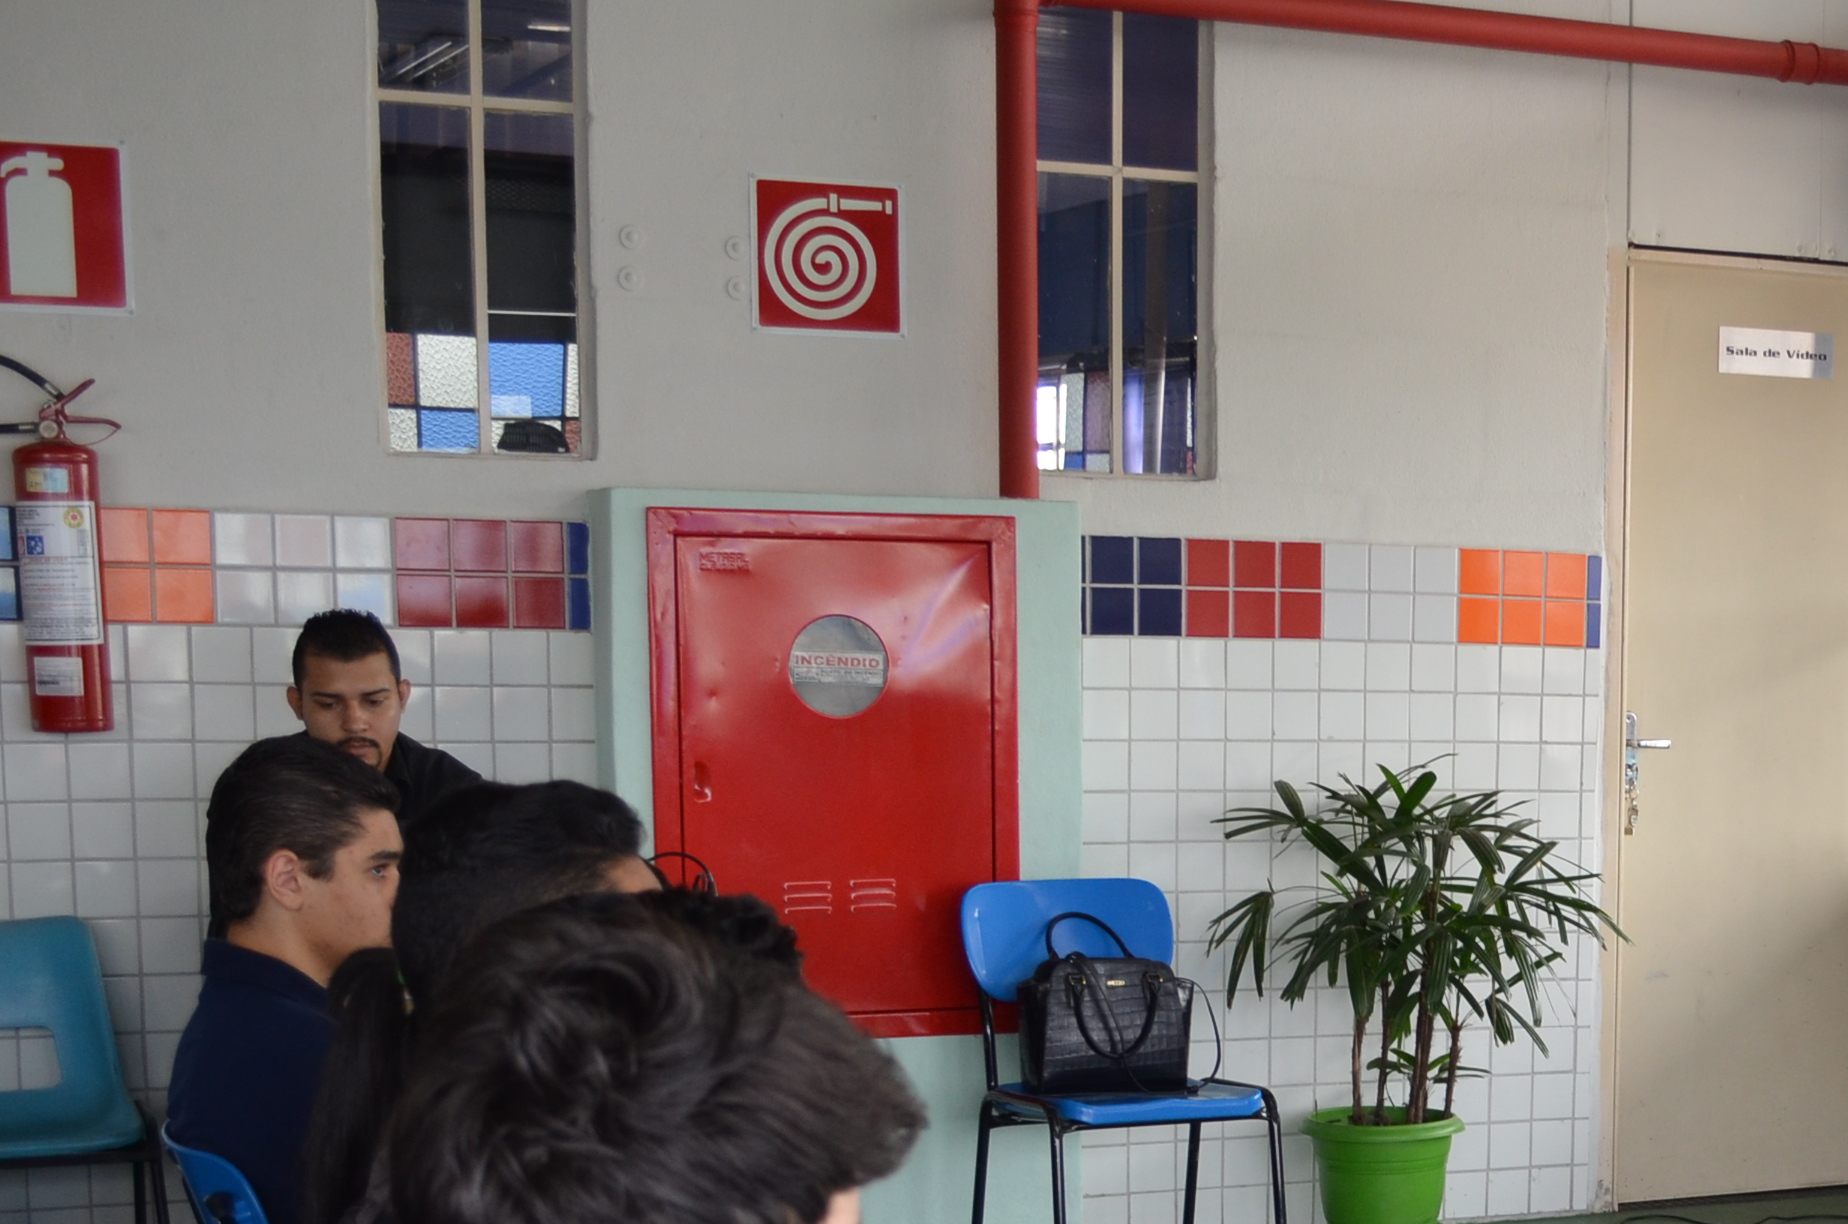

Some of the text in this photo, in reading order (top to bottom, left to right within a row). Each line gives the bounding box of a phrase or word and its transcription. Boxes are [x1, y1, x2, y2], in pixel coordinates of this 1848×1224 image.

[1726, 346, 1757, 357] Sala
[1763, 348, 1780, 358] de
[795, 653, 880, 669] INCÊNDIO
